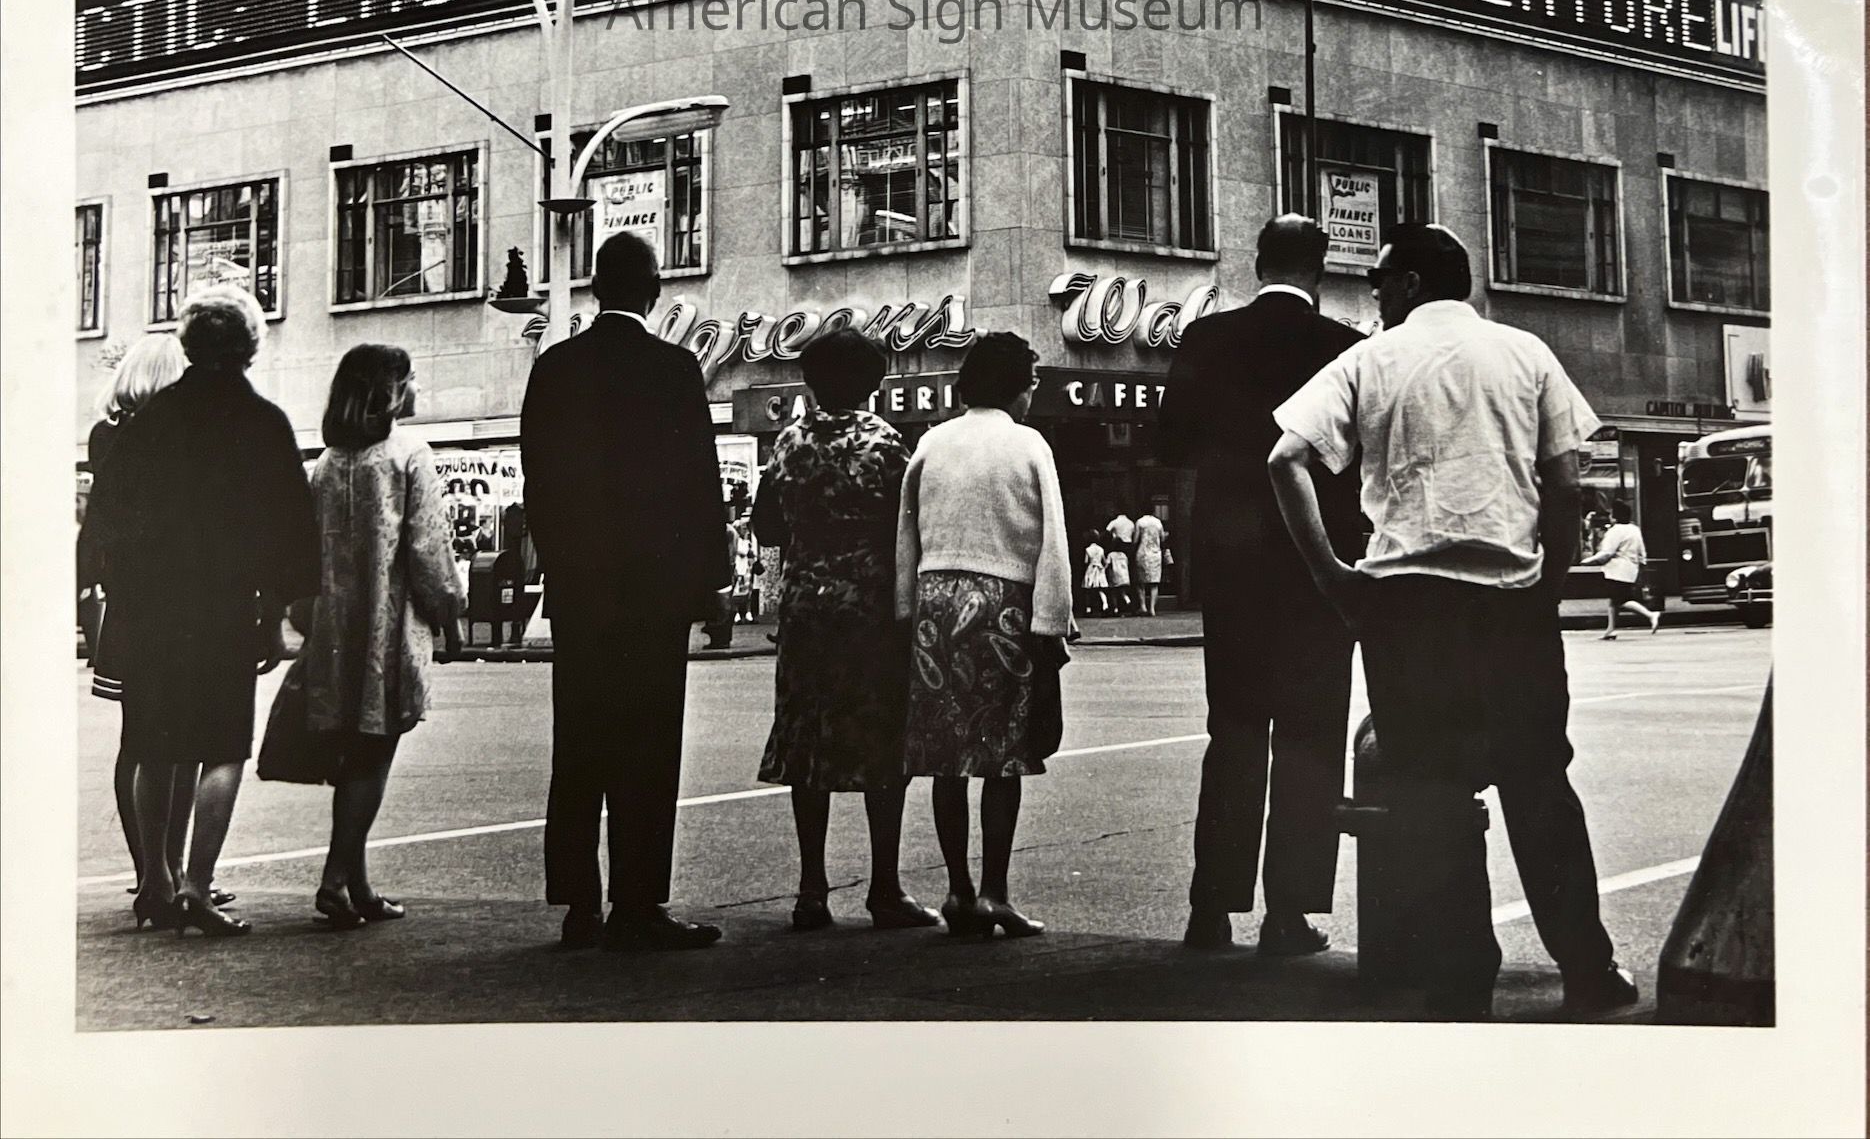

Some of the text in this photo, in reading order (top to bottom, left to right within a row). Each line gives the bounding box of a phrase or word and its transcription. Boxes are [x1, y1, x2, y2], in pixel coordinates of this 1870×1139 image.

[610, 182, 654, 198] PUBLIC
[1334, 177, 1371, 193] PUBLIC
[603, 212, 656, 228] FINANCE
[1328, 207, 1374, 223] FINANCE
[1332, 226, 1372, 240] LOANS
[765, 384, 953, 421] CATERI
